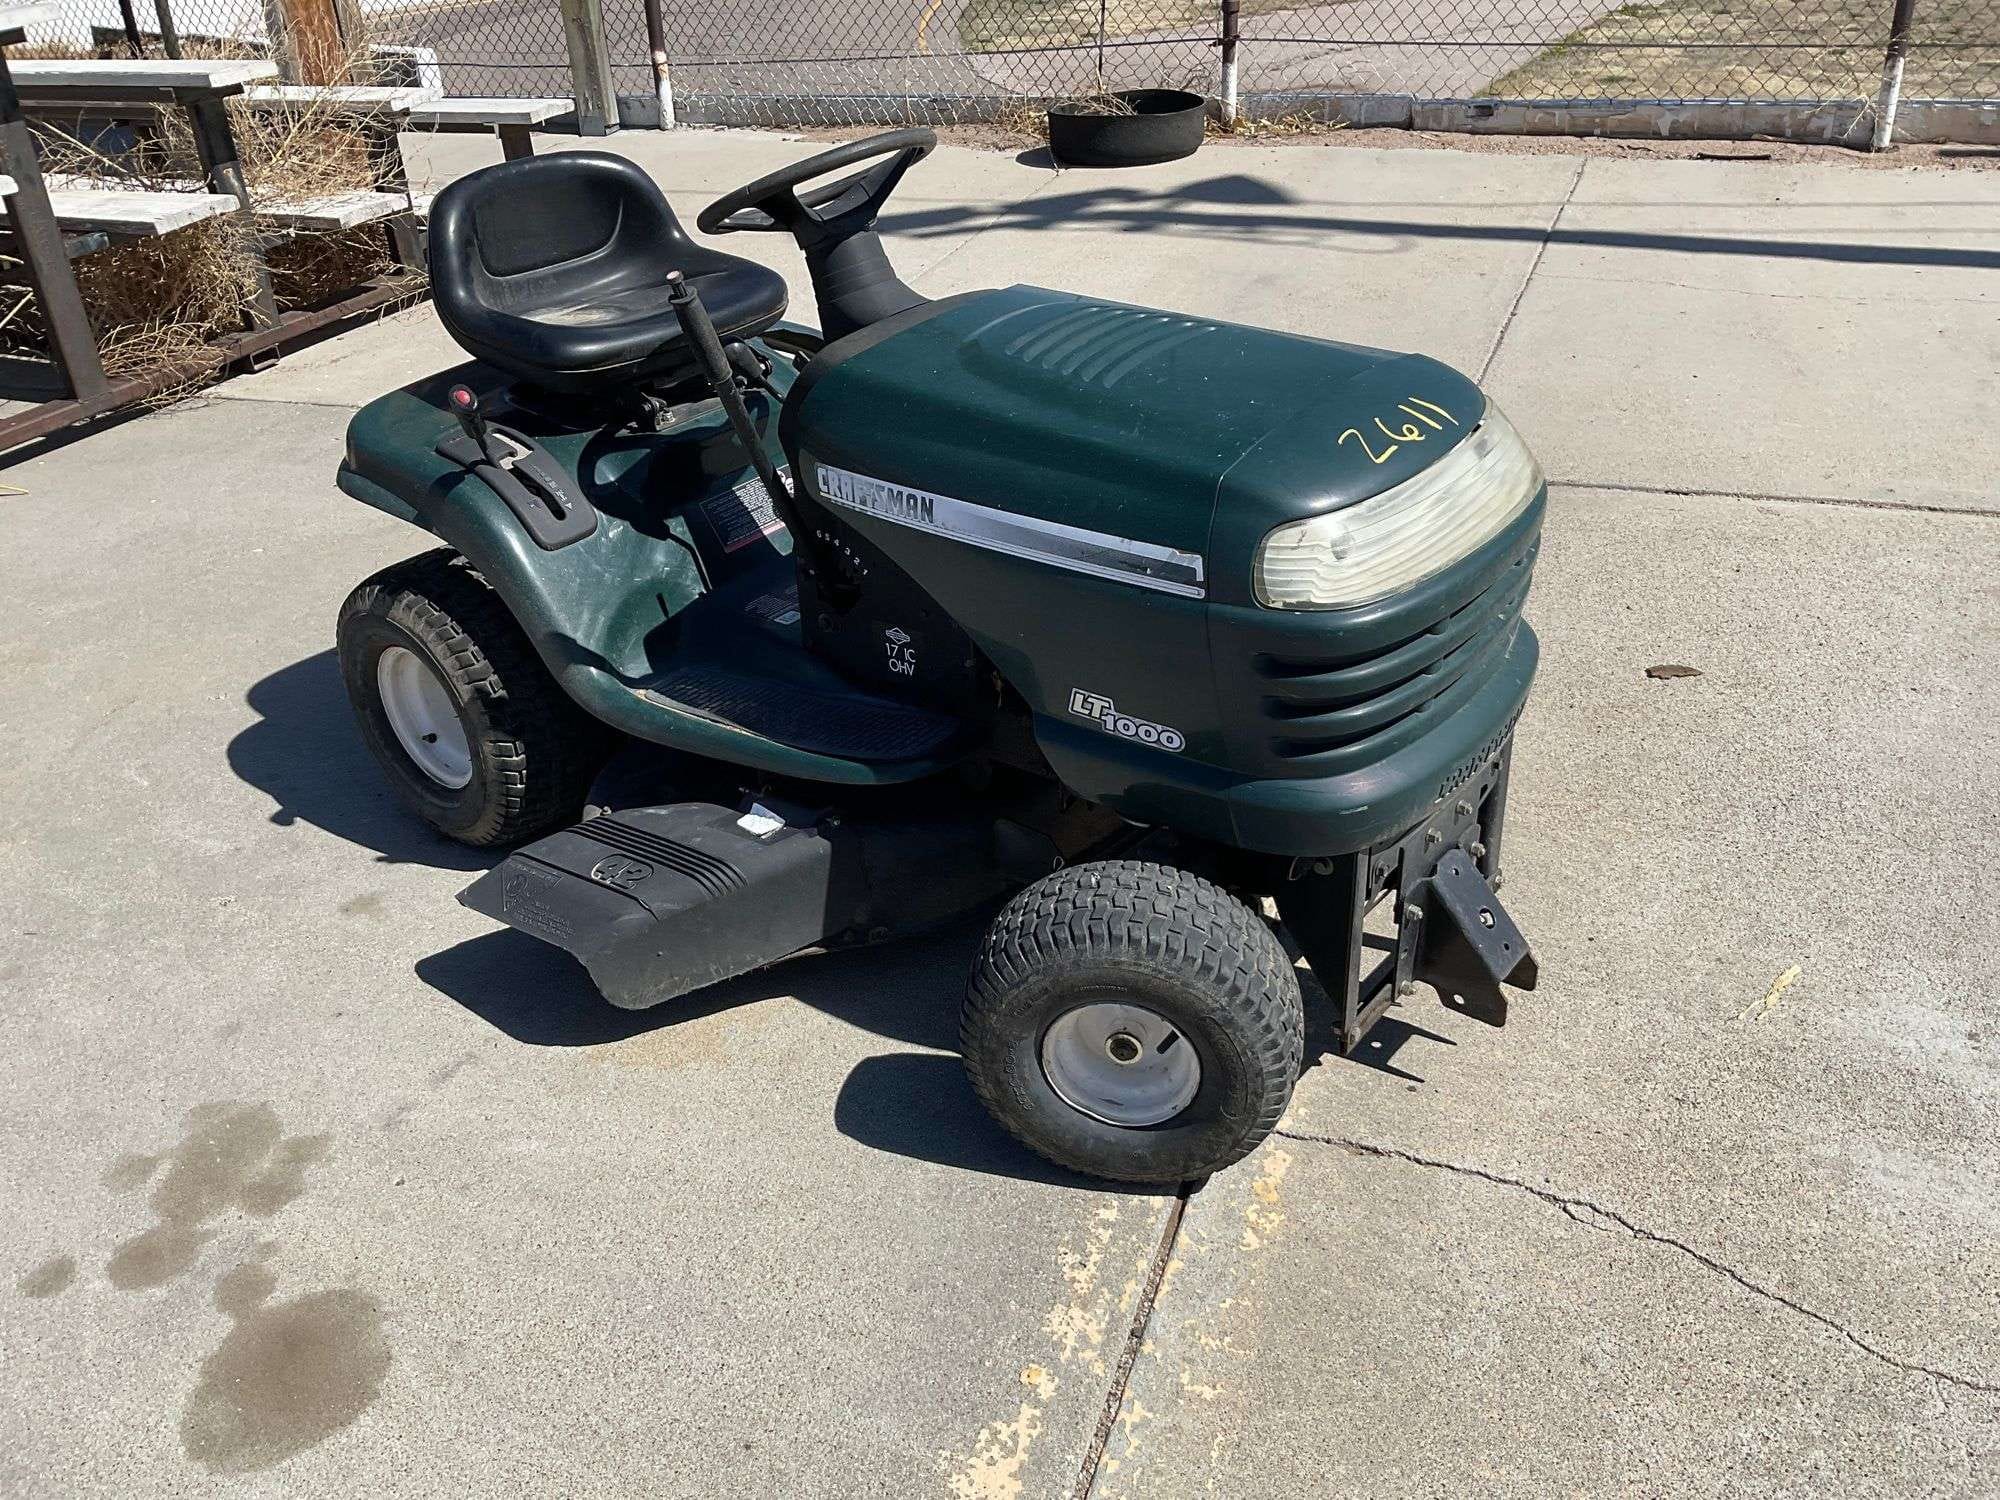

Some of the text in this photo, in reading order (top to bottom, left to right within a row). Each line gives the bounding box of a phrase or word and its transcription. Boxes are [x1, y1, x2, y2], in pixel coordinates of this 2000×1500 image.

[1338, 397, 1459, 464] 2611
[889, 658, 914, 676] OHV
[591, 854, 655, 889] 42
